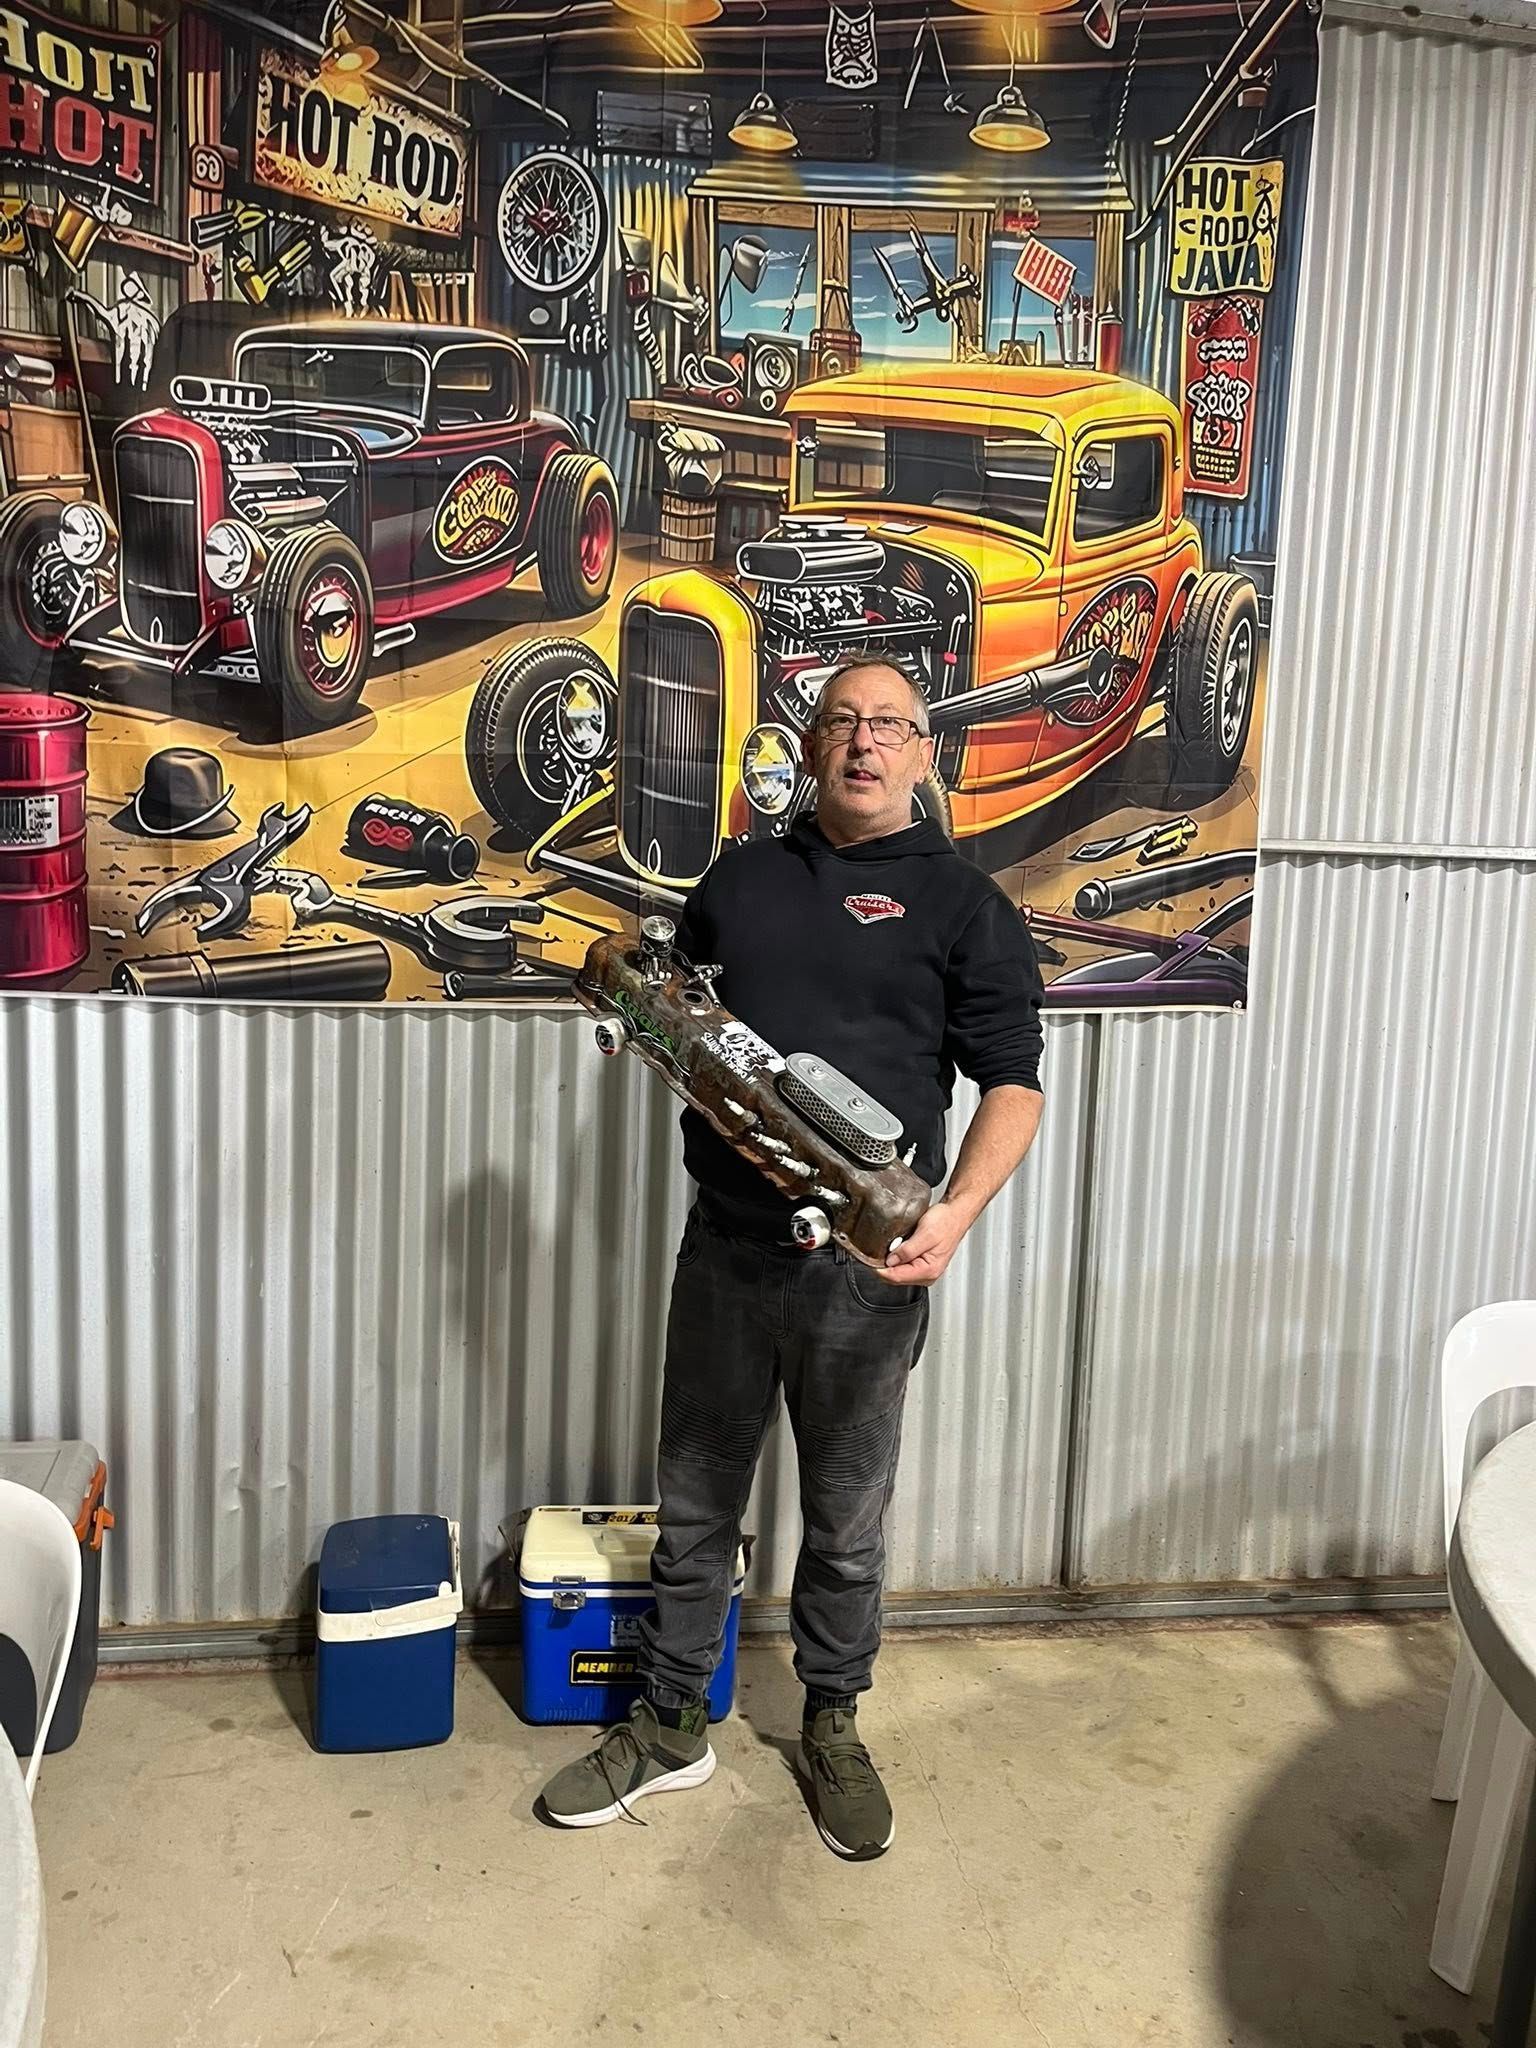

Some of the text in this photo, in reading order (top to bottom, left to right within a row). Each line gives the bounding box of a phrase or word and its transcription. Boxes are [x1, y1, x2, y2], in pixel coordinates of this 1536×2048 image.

[0, 73, 154, 184] HOT
[264, 73, 460, 206] HOT ROD
[1183, 166, 1251, 212] HOT
[1199, 214, 1250, 248] ROD
[1177, 242, 1264, 292] JAVA
[576, 1662, 634, 1674] MEMBER
